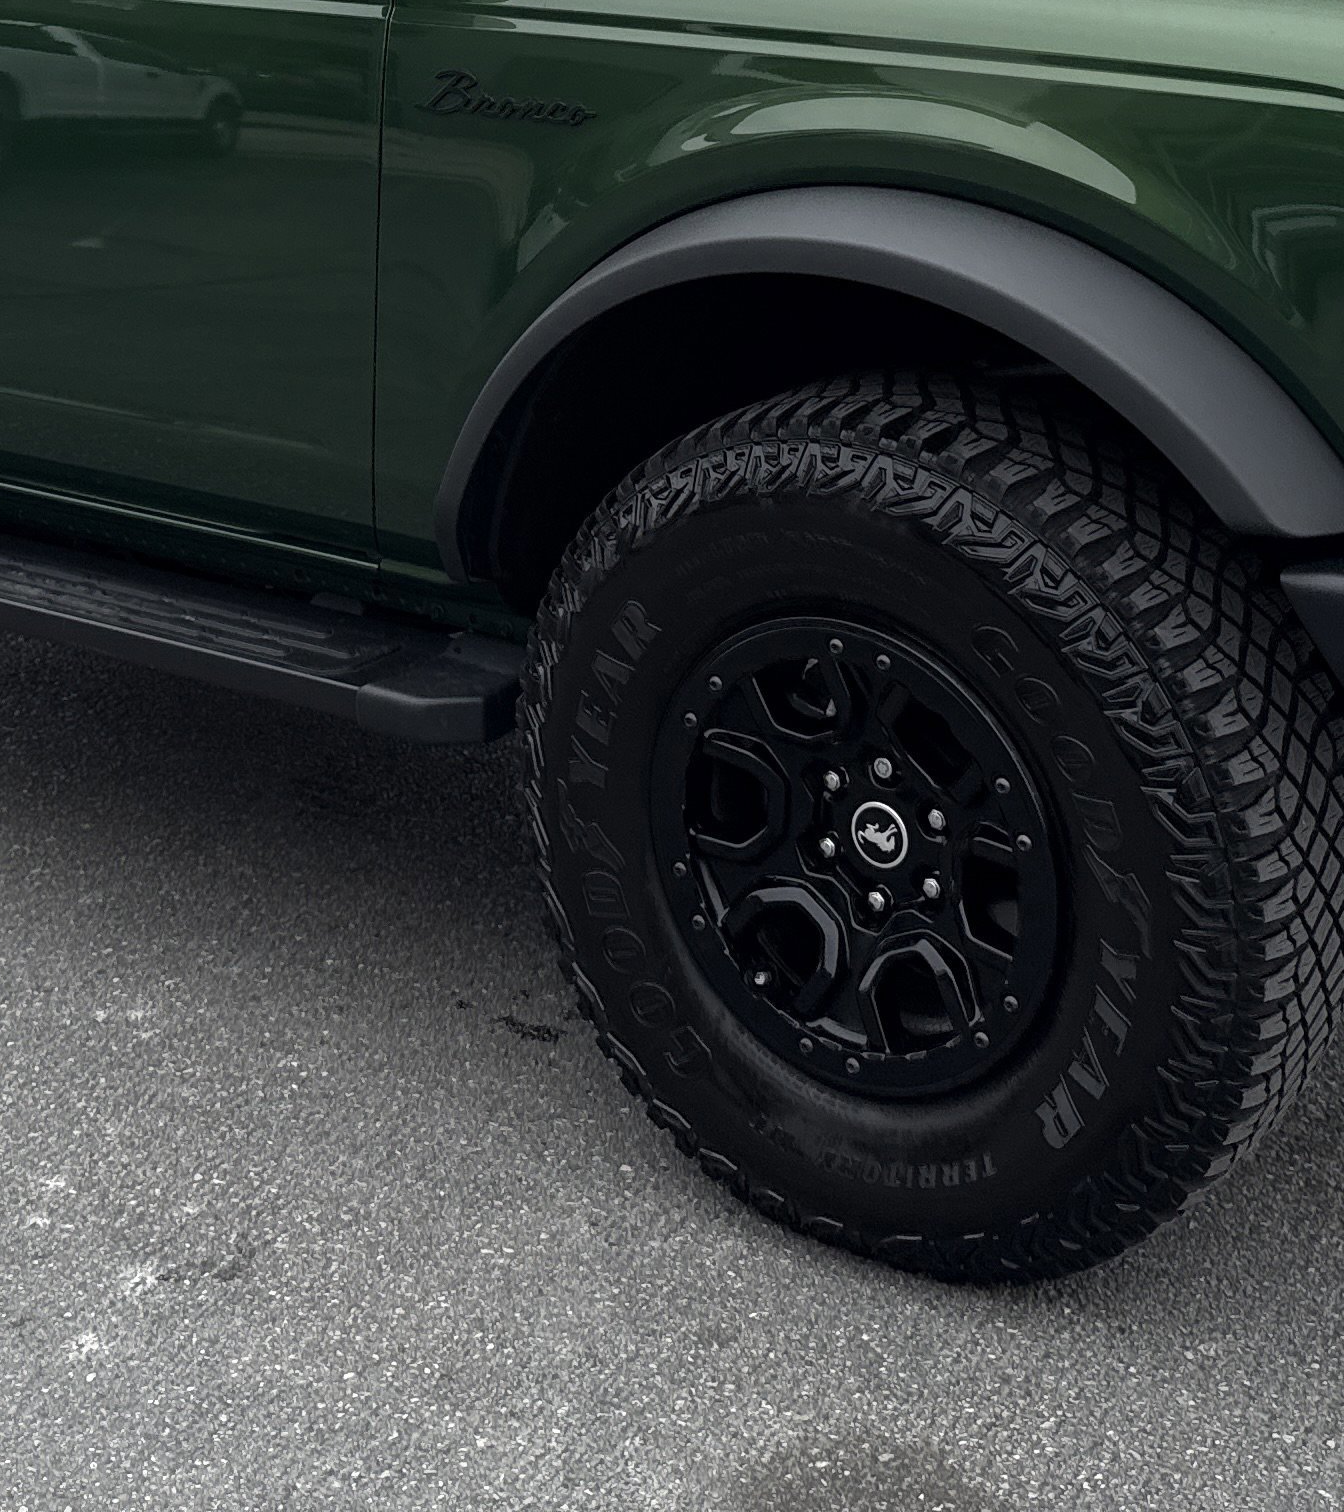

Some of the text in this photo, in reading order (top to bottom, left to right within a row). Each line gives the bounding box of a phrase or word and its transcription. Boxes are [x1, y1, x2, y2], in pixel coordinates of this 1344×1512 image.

[415, 69, 599, 127] Bronco
[560, 598, 713, 1079] GOODYEAR
[970, 624, 1151, 1150] GOODYEAR
